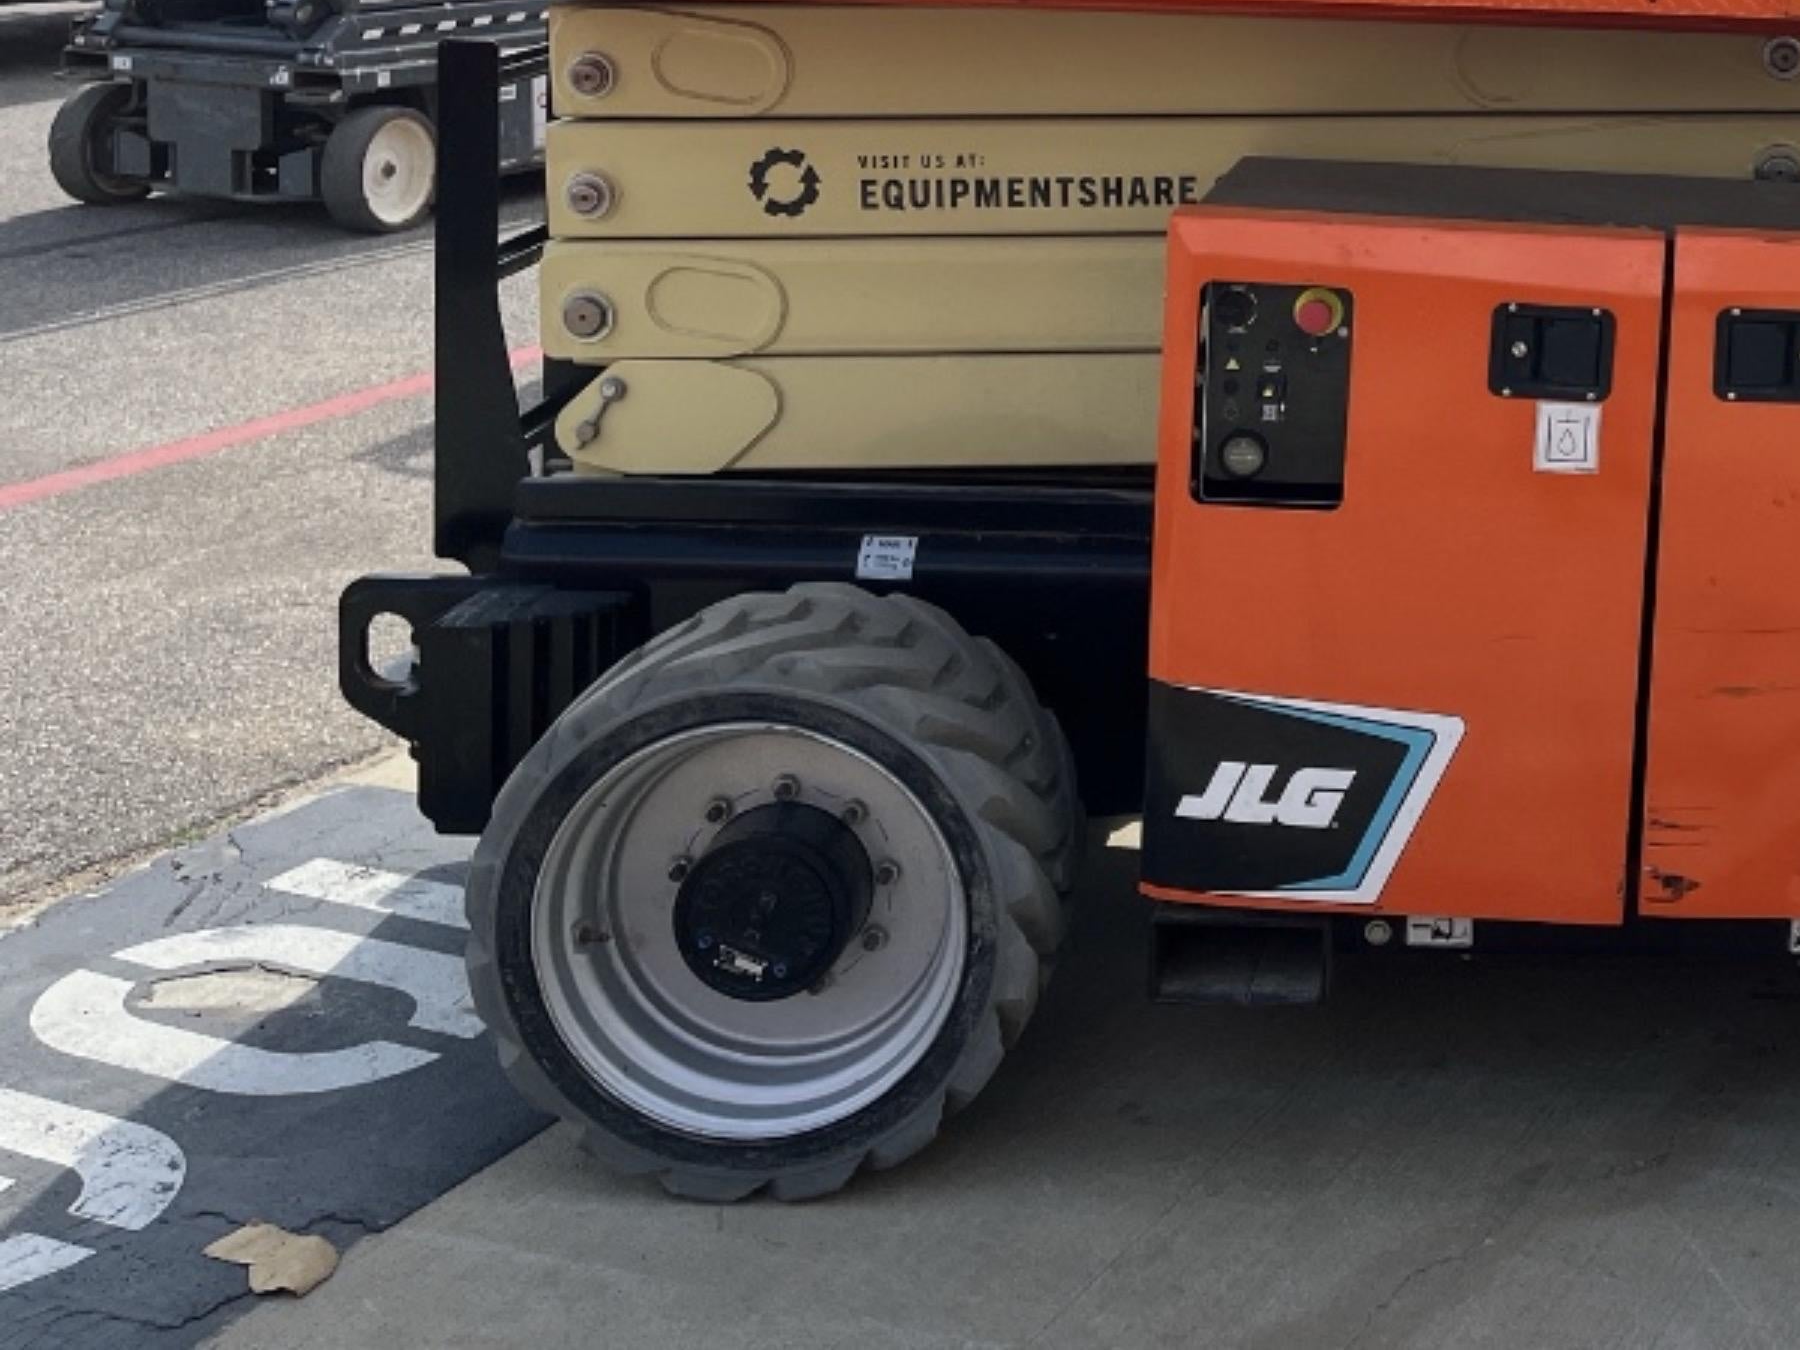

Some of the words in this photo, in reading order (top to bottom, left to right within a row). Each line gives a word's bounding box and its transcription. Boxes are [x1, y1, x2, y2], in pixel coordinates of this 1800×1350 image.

[858, 154, 910, 169] VISIT
[921, 154, 945, 169] US
[859, 176, 1198, 211] EQUIPMENTSHARE
[1174, 761, 1358, 829] JLG
